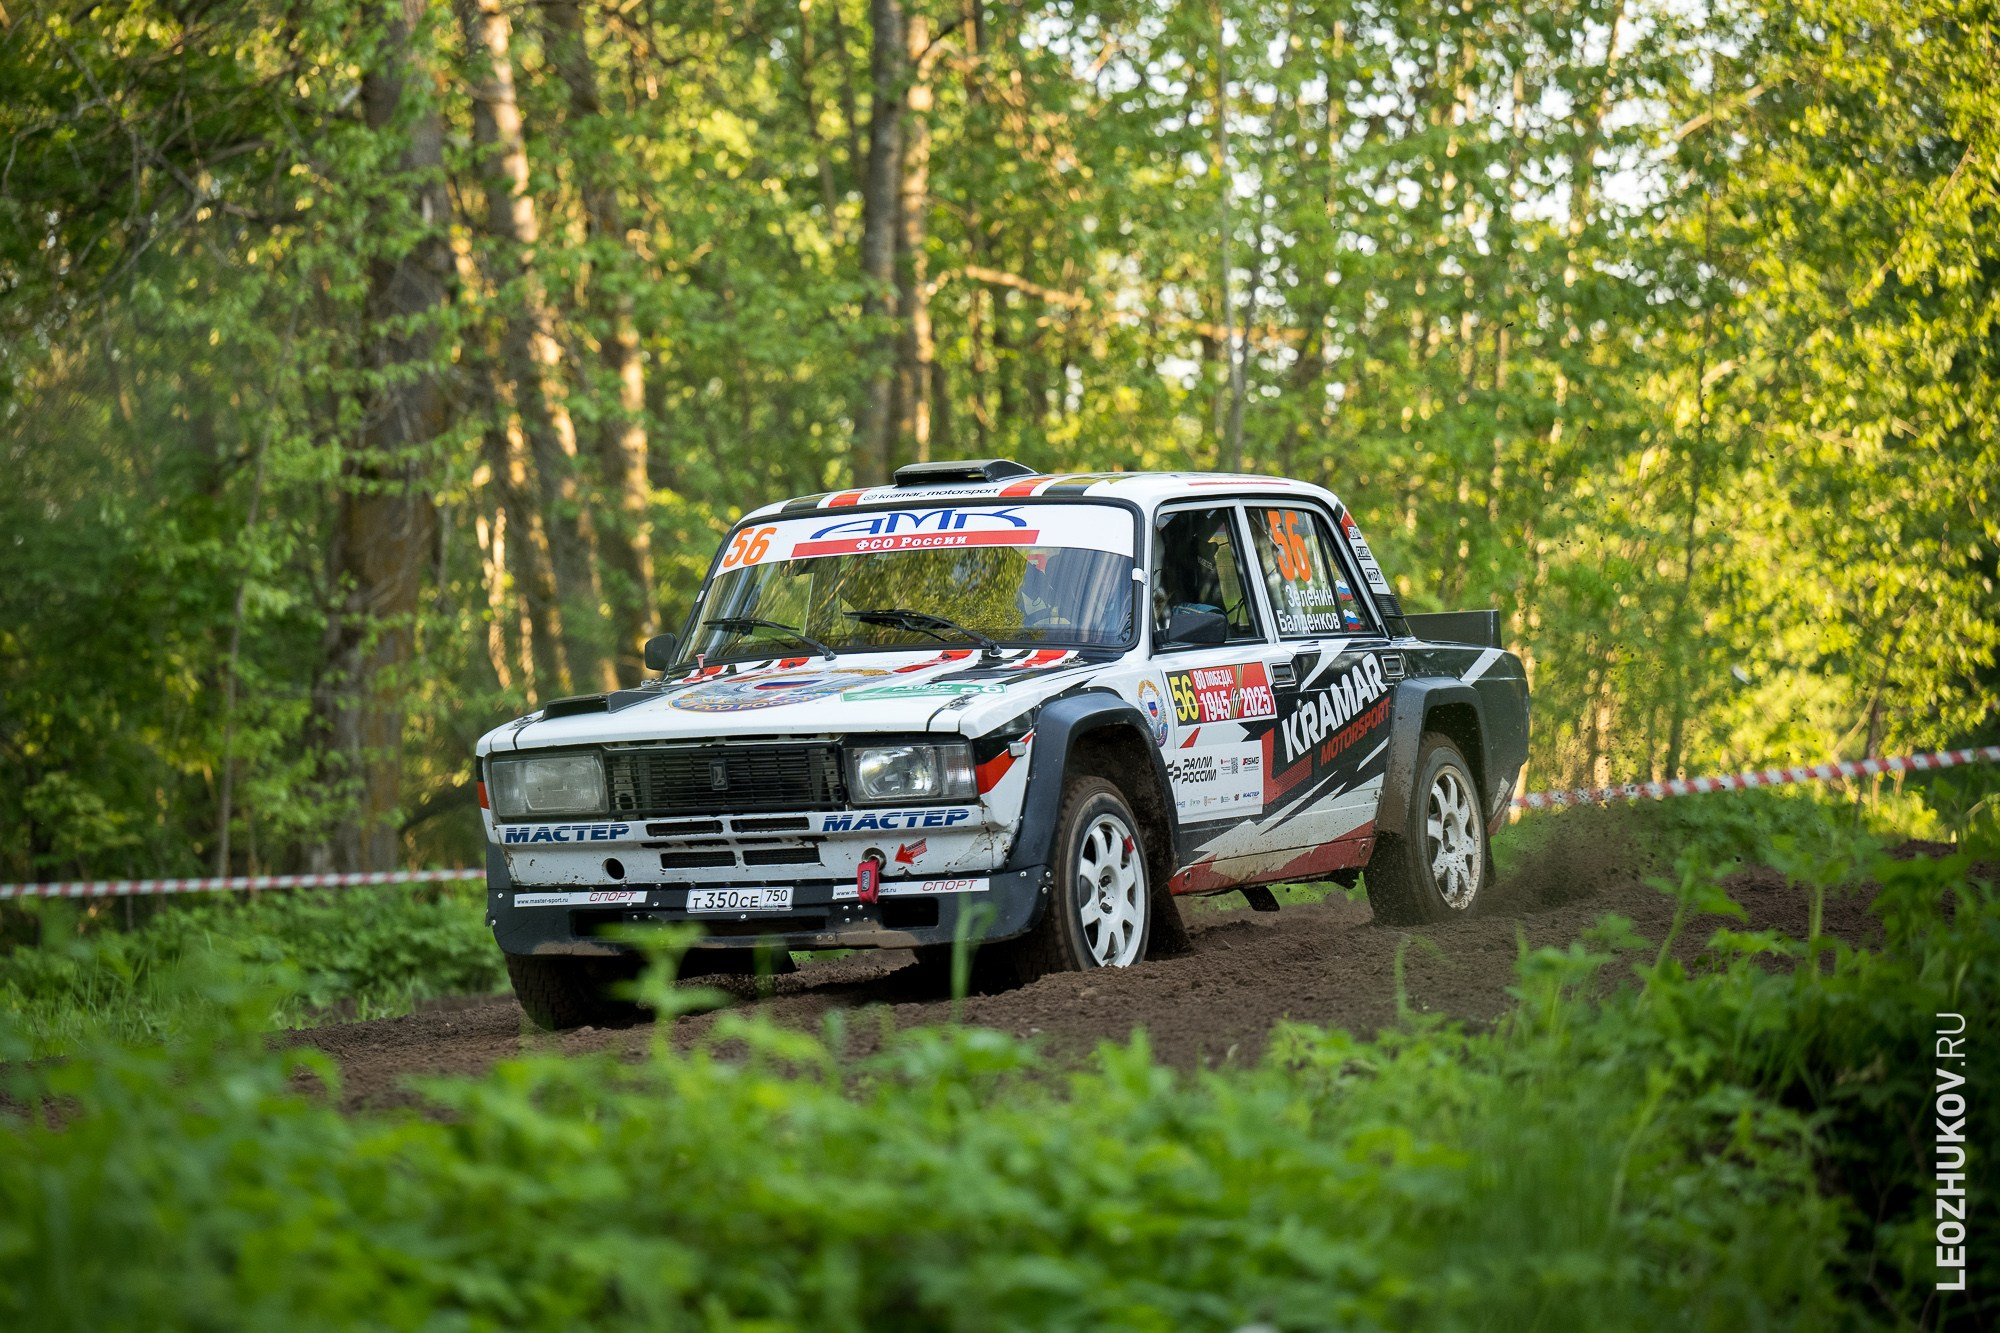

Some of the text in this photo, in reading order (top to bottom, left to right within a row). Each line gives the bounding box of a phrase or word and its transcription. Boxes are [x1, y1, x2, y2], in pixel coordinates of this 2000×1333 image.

[723, 527, 777, 568] 56
[855, 535, 967, 551] ФСО России
[1267, 509, 1312, 582] 56
[1285, 585, 1335, 608] Зеленин
[1276, 610, 1341, 634] Балденков
[1193, 669, 1234, 690] 80 ПОБЕДА!
[1169, 675, 1199, 722] 56
[1200, 685, 1272, 722] 1945 2025
[1281, 652, 1388, 764] KRAMAR
[1321, 696, 1390, 766] MOTORSPORT
[1183, 756, 1213, 771] РАЛЛИ
[1182, 769, 1217, 784] РОССИИ
[822, 809, 969, 832] МАСТЕР
[505, 824, 630, 844] МАСТЕР
[589, 892, 636, 902] СПОРТ
[766, 889, 788, 903] 750
[922, 879, 977, 892] СПОРТ
